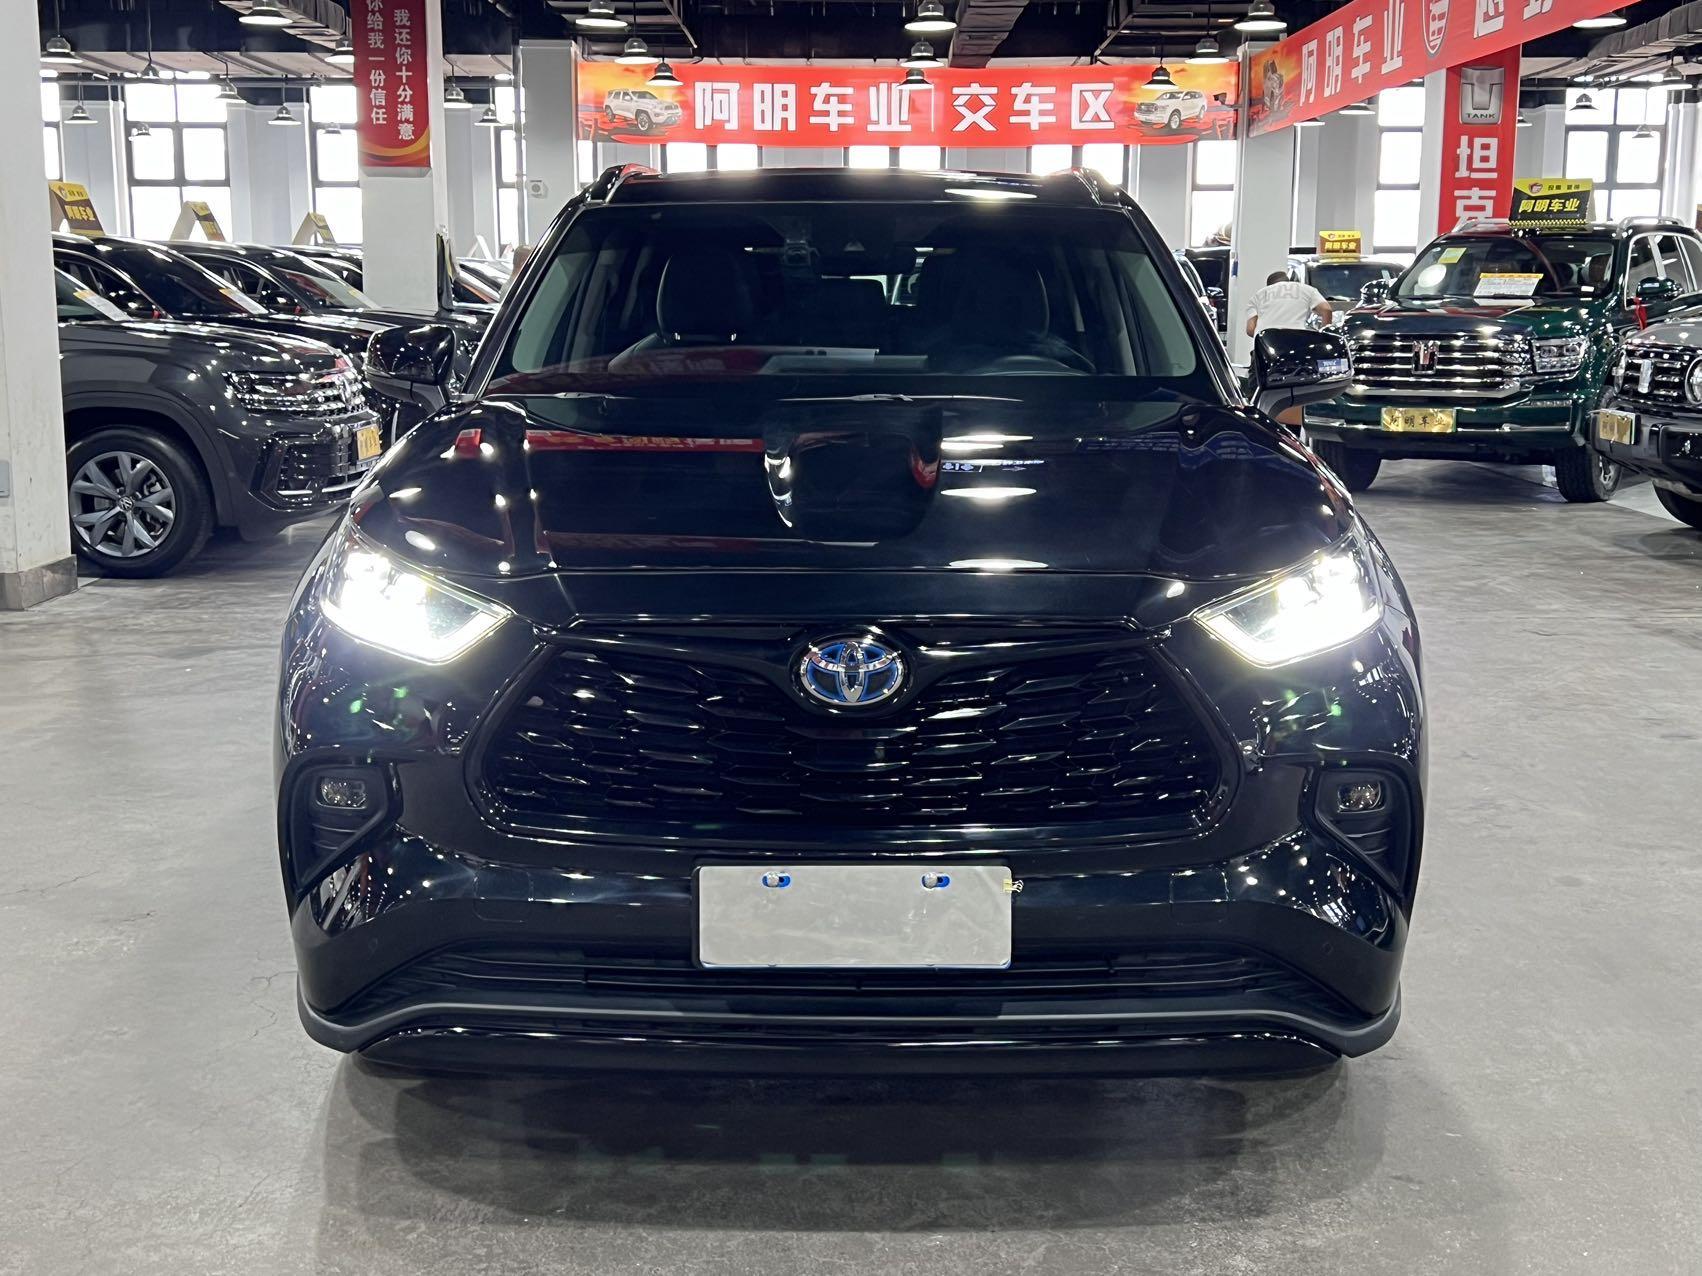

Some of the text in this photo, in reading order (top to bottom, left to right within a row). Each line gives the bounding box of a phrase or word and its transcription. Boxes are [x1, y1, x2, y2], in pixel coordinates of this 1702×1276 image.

[366, 0, 387, 125] 你给我一份信任
[394, 9, 415, 140] 我还你十分满意
[1300, 0, 1405, 106] 阿明车业
[694, 81, 912, 132] 阿明车业
[951, 82, 1115, 132] 交车区
[1453, 135, 1499, 229] 坦克
[1518, 198, 1580, 213] 阿明车业
